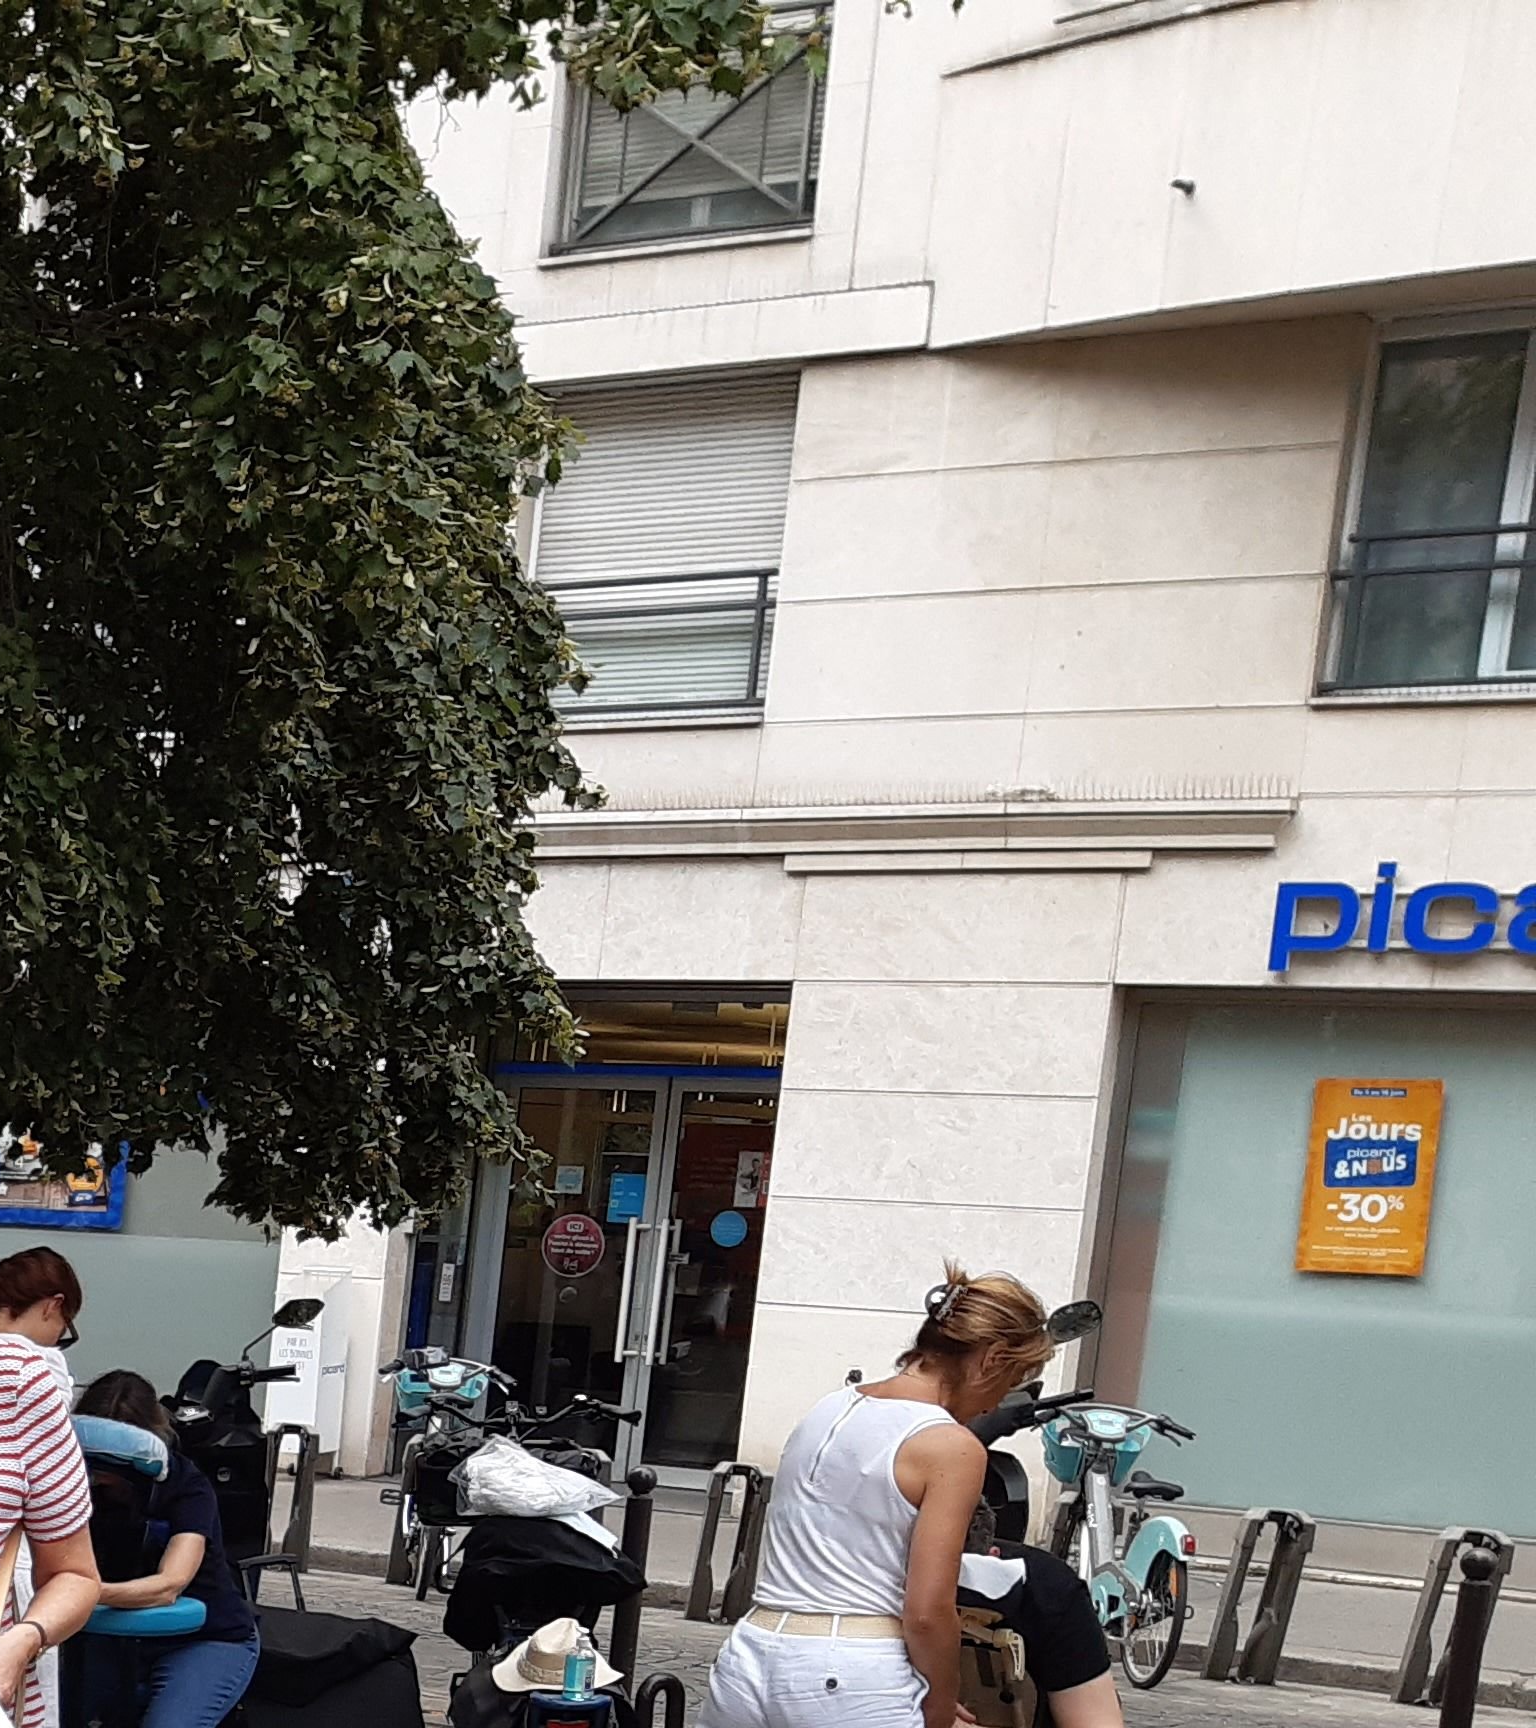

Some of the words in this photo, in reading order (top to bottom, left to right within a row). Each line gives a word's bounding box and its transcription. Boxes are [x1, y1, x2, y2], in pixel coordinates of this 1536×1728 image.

[1327, 1117, 1422, 1141] Jours
[1346, 1147, 1396, 1159] picard
[1327, 1193, 1405, 1223] -30%
